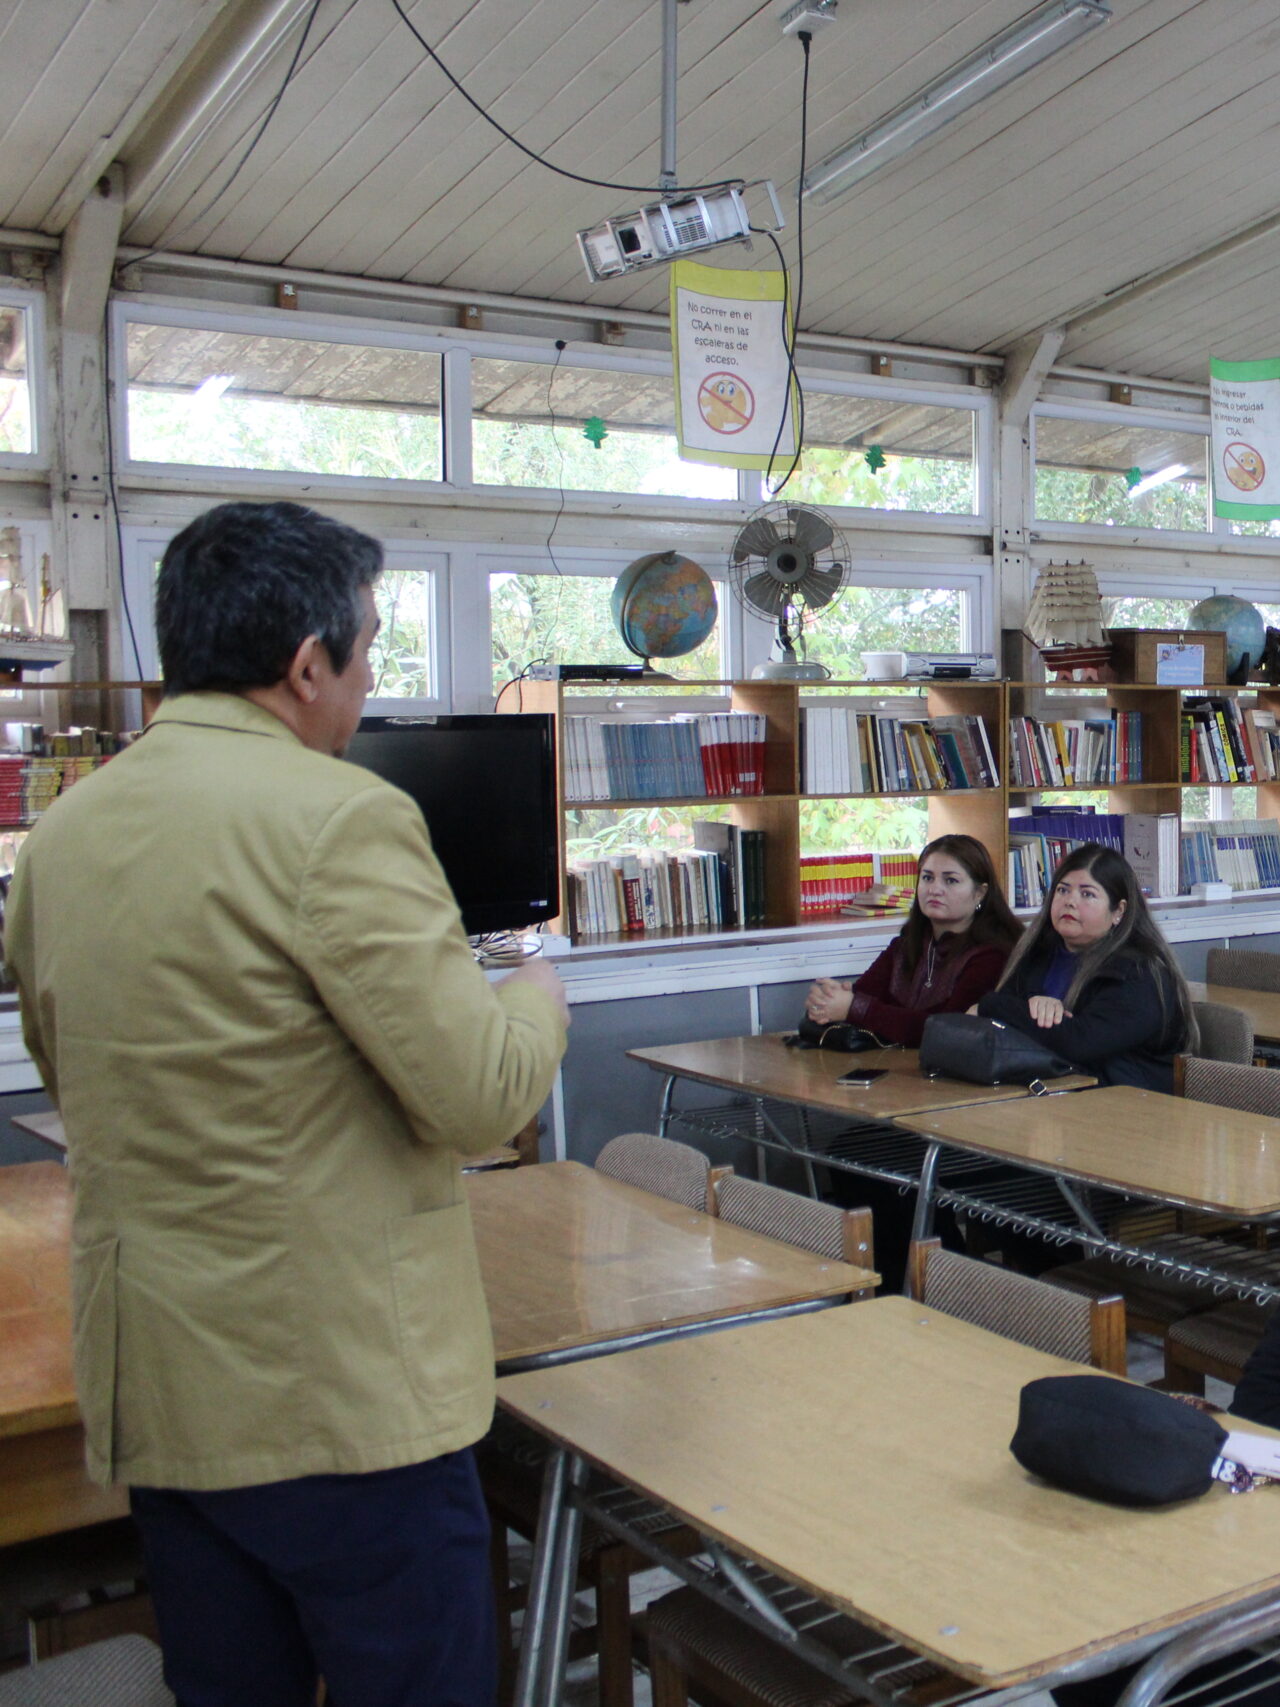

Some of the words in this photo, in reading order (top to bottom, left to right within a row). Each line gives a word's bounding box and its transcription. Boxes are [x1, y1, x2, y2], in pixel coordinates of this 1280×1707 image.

[688, 301, 698, 312] No
[700, 305, 727, 317] correr
[730, 310, 741, 319] en
[743, 311, 752, 320] el
[691, 318, 712, 332] CRA
[714, 323, 722, 332] ni
[723, 325, 735, 334] en
[737, 326, 750, 336] las
[694, 337, 735, 350] escaleras
[736, 341, 748, 351] de
[705, 354, 739, 366] acceso.
[1236, 403, 1264, 411] bebidas
[1242, 416, 1255, 424] del
